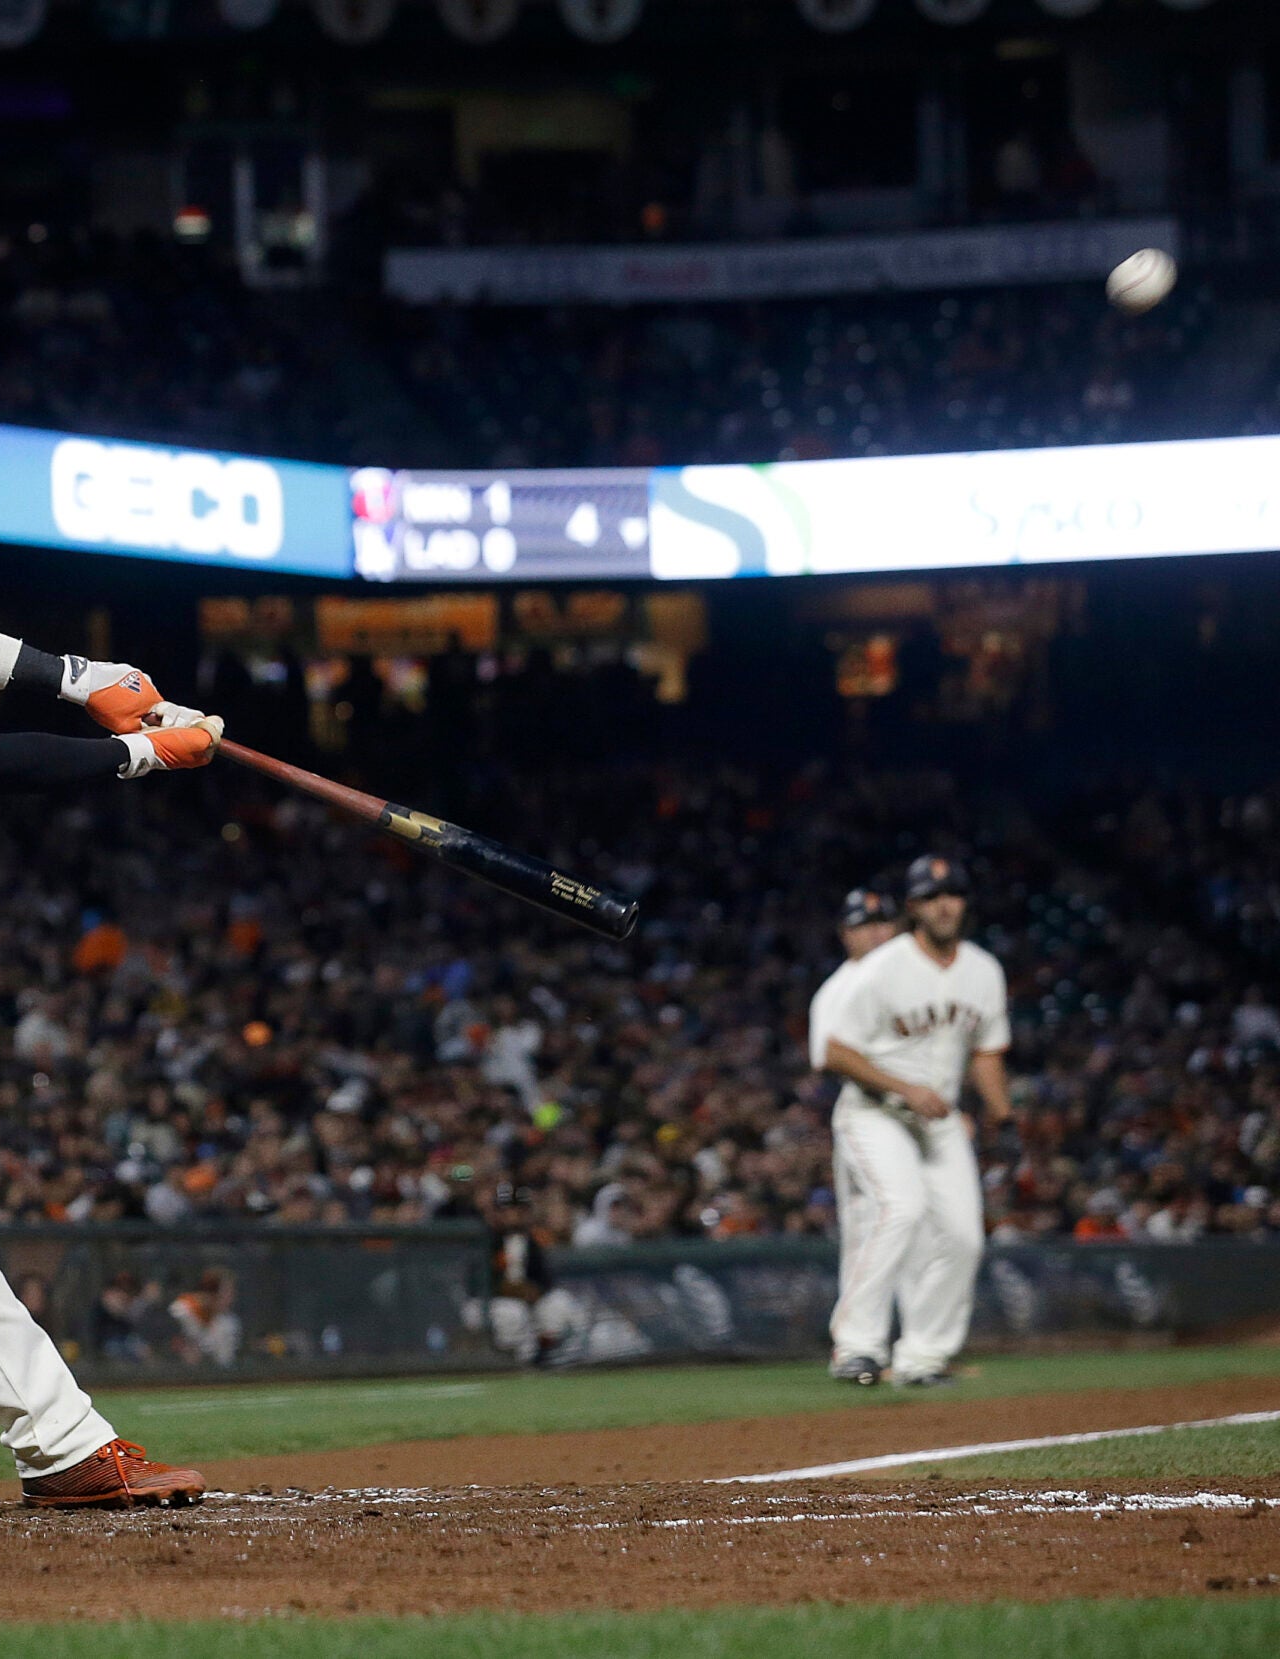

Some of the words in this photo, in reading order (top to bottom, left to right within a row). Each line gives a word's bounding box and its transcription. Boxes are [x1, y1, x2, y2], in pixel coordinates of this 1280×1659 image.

[51, 438, 282, 560] GEICO
[486, 480, 511, 525] 1
[566, 502, 600, 547] 4
